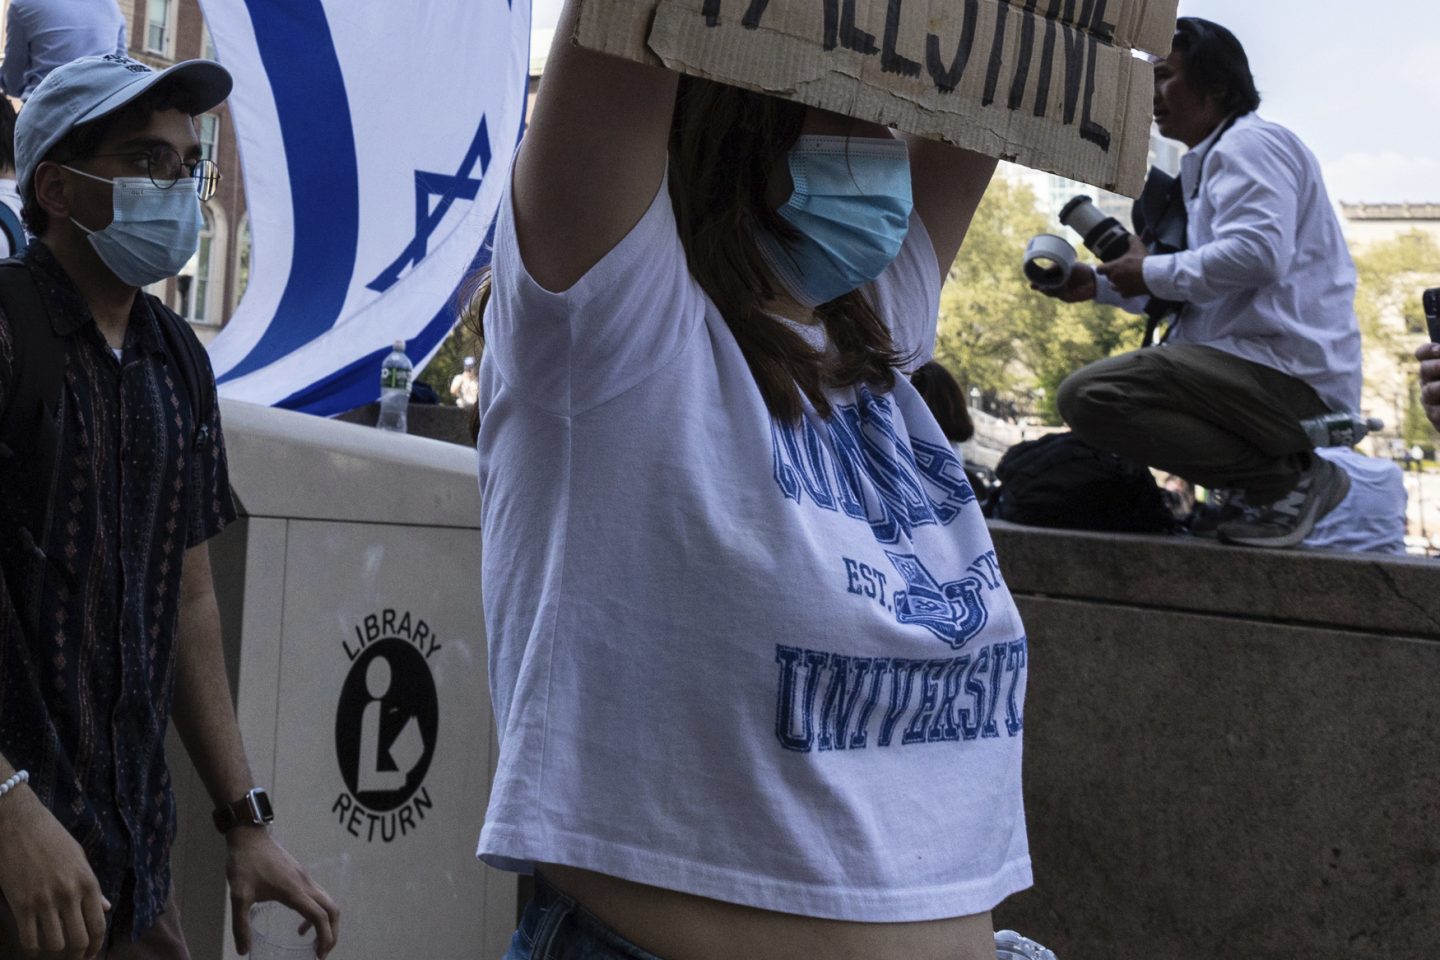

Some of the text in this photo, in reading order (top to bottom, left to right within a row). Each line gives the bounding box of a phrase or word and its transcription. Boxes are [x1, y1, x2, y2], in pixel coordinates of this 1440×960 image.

[842, 556, 892, 613] EST.
[342, 608, 442, 662] LIBRARY
[332, 786, 434, 843] RETURN
